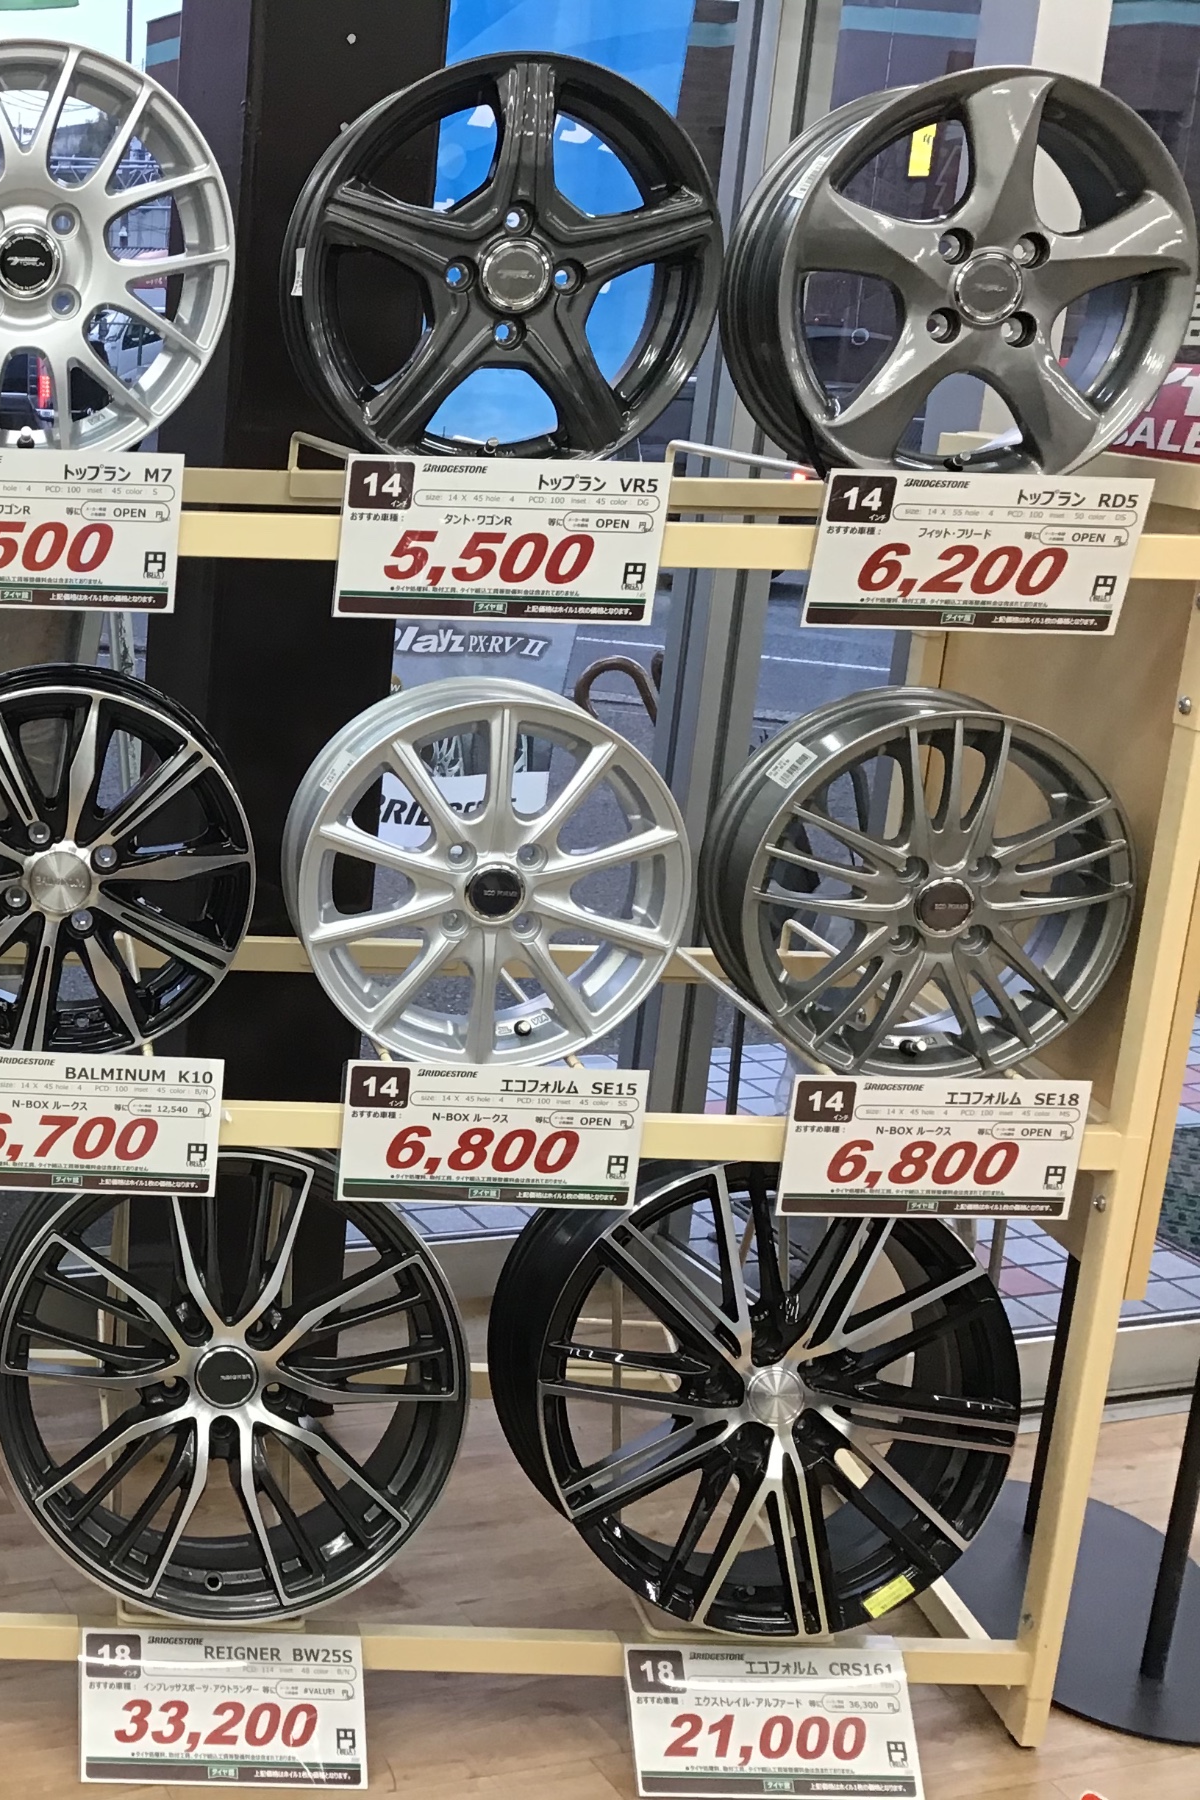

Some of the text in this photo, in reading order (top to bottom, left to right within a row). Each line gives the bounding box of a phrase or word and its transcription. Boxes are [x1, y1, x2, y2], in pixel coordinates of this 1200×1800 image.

[1112, 416, 1200, 456] ALE
[64, 464, 172, 482] トップラン M7
[422, 463, 488, 474] BRIDGESTONE
[363, 472, 402, 497] 14
[538, 474, 658, 493] トップラン VR5
[904, 478, 970, 489] BRIDGESTONE
[842, 486, 882, 511] 14
[1017, 489, 1138, 508] トップラン RD5
[113, 508, 146, 518] OPEN
[596, 518, 629, 529] OPEN
[1072, 533, 1105, 543] OPEN
[144, 552, 166, 573] 円
[384, 530, 646, 586] 5,500 円
[857, 542, 1117, 598] 6,200 円
[395, 626, 467, 653] layz
[65, 1067, 213, 1084] BALMINUM K10
[417, 1069, 478, 1079] BRIDGESTONE
[363, 1076, 399, 1098] 14
[501, 1080, 637, 1096] エコフォルム SE15
[863, 1083, 924, 1092] BRIDGESTONE
[12, 1100, 49, 1109] N-BOX
[157, 1105, 188, 1114] 12,540
[808, 1091, 844, 1112] 14
[945, 1092, 1079, 1106] エコフォルム SE18
[432, 1113, 470, 1123] N-BOX
[580, 1116, 612, 1126] OPEN
[876, 1127, 913, 1136] N-BOX
[1021, 1128, 1052, 1137] OPEN
[187, 1143, 208, 1162] 円
[386, 1125, 628, 1175] 6,800 円
[826, 1139, 1066, 1188] 6,800 円
[148, 1636, 203, 1645] BRIDGESTONE
[204, 1646, 353, 1663] REIGNER BW25S
[689, 1652, 745, 1661] BRIDGESTONE
[640, 1661, 674, 1681] 18
[746, 1661, 892, 1676] エコフォルム CRS161
[849, 1701, 878, 1709] 36,300
[114, 1699, 356, 1753] 33,200 円
[664, 1713, 907, 1766] 21,000 円
